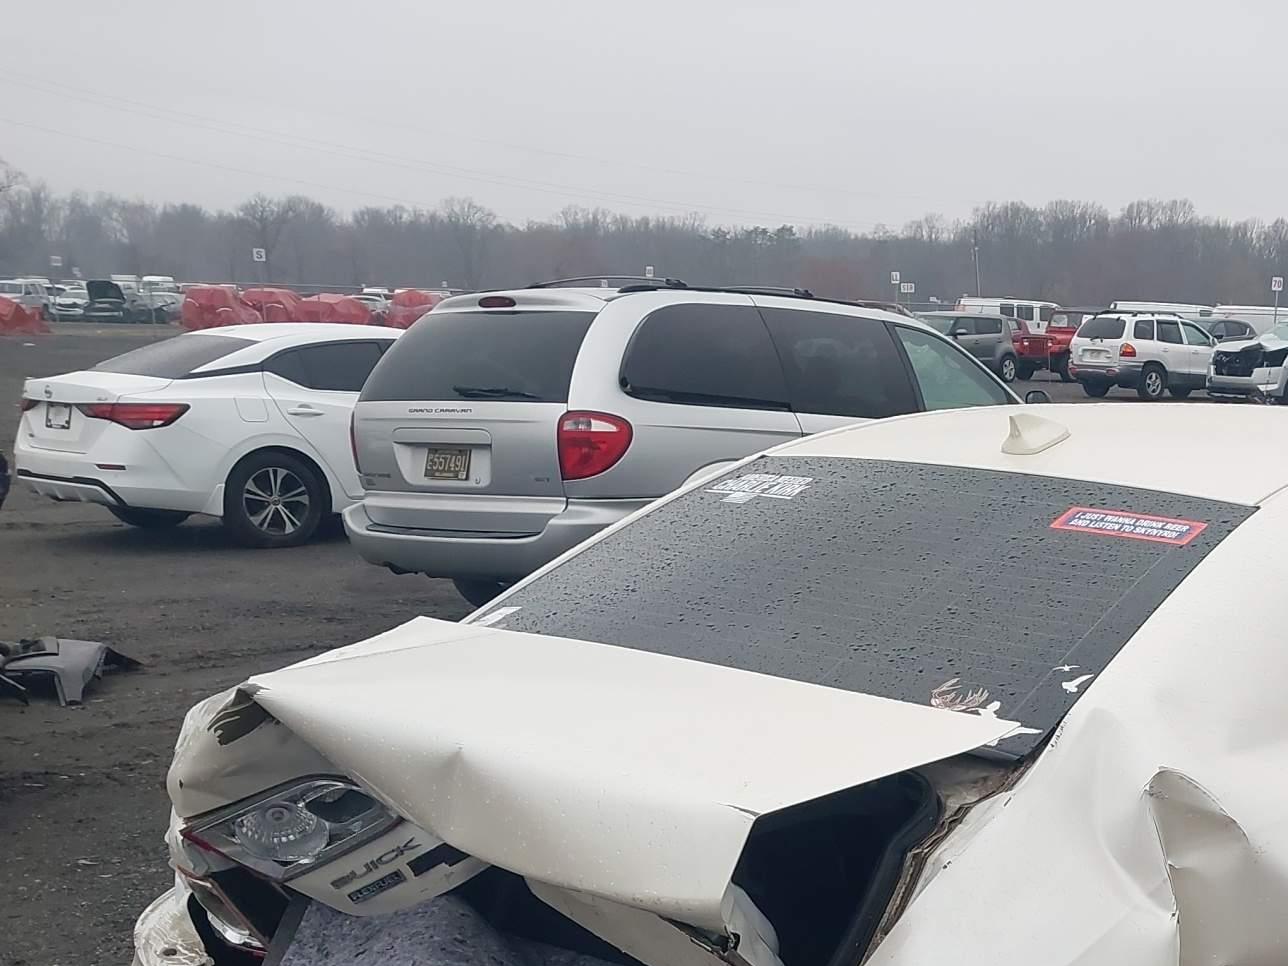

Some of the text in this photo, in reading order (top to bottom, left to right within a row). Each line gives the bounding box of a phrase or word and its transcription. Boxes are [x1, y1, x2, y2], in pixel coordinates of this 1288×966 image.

[1272, 279, 1282, 289] 70
[1120, 524, 1135, 532] TO
[1163, 523, 1190, 532] BEER
